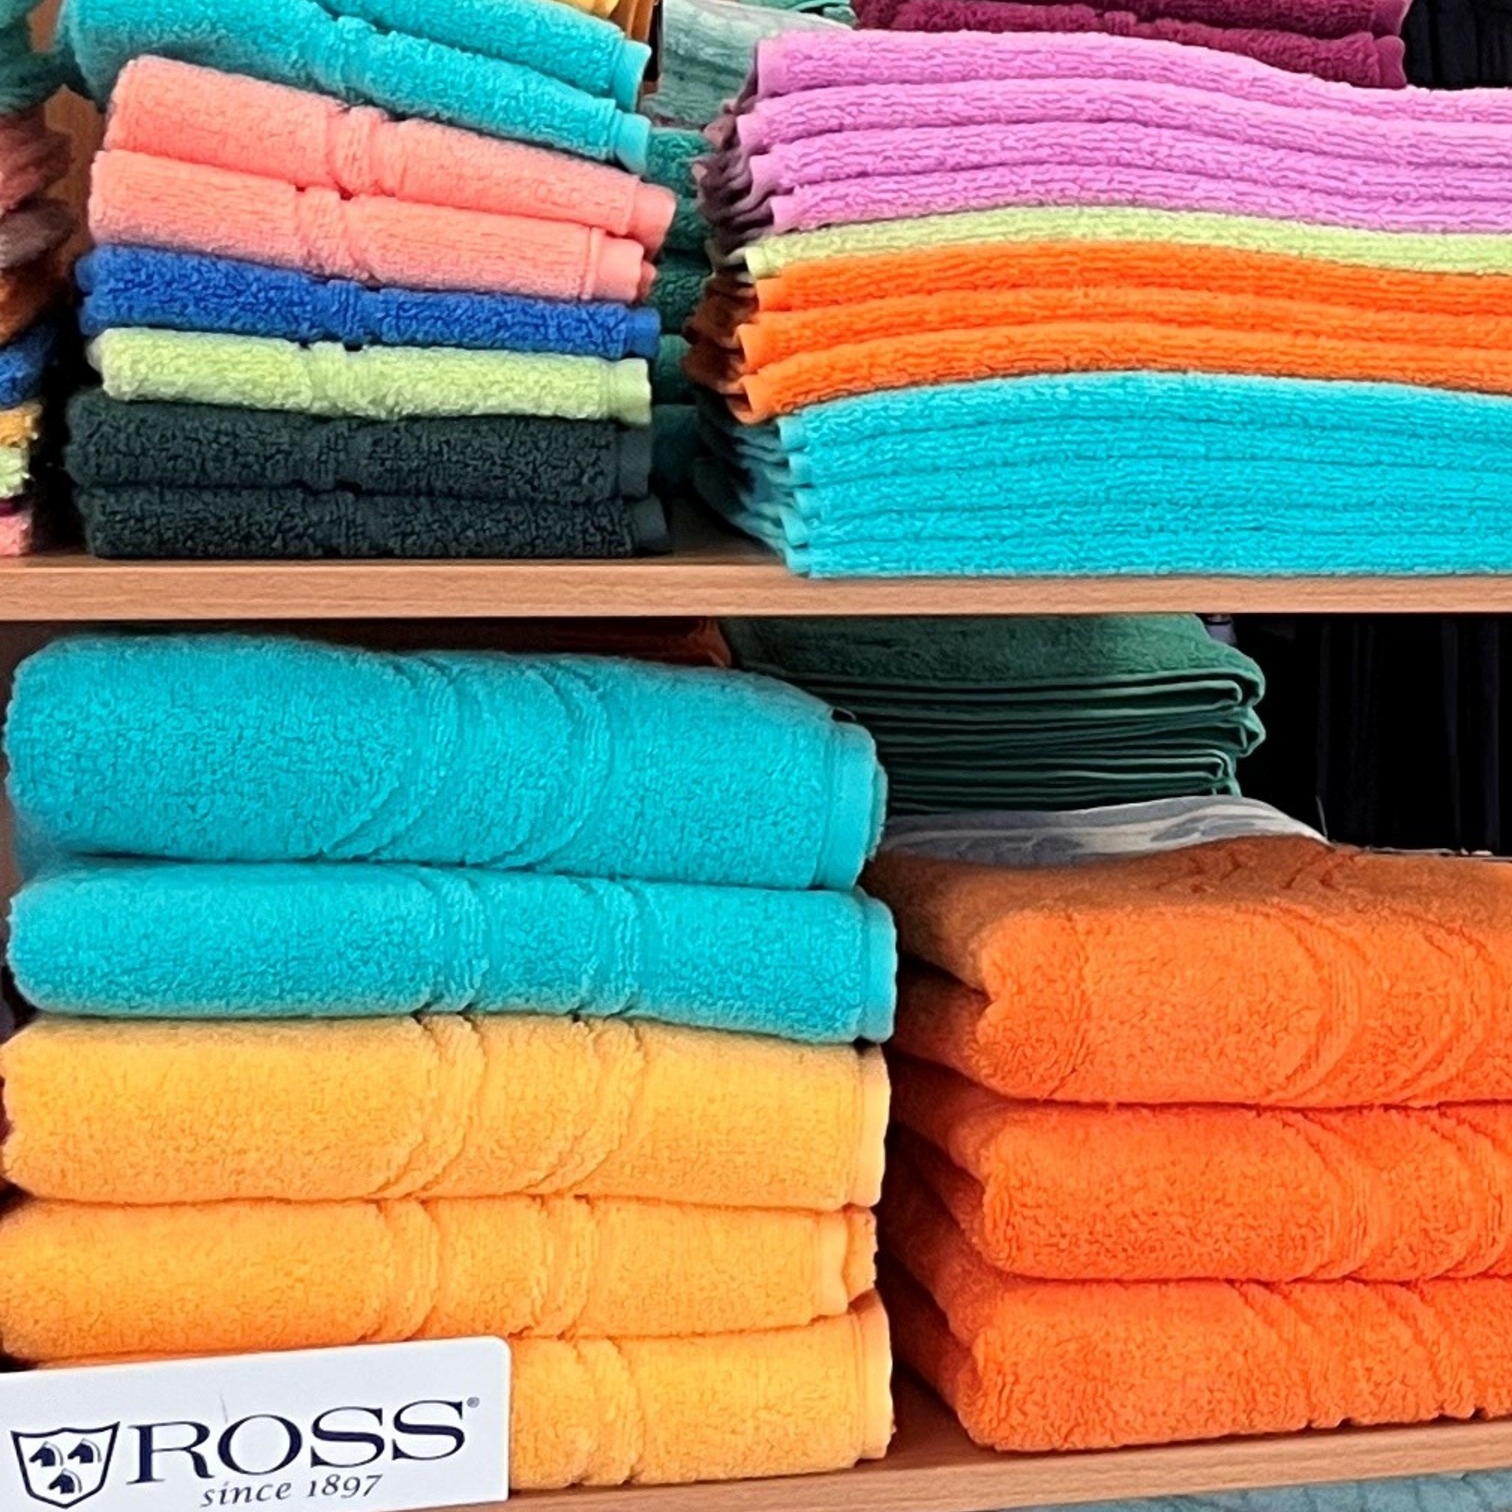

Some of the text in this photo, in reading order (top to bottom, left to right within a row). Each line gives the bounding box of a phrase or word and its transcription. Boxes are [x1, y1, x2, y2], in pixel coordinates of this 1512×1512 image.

[126, 1399, 466, 1486] ROSS
[199, 1473, 384, 1508] since 1897
